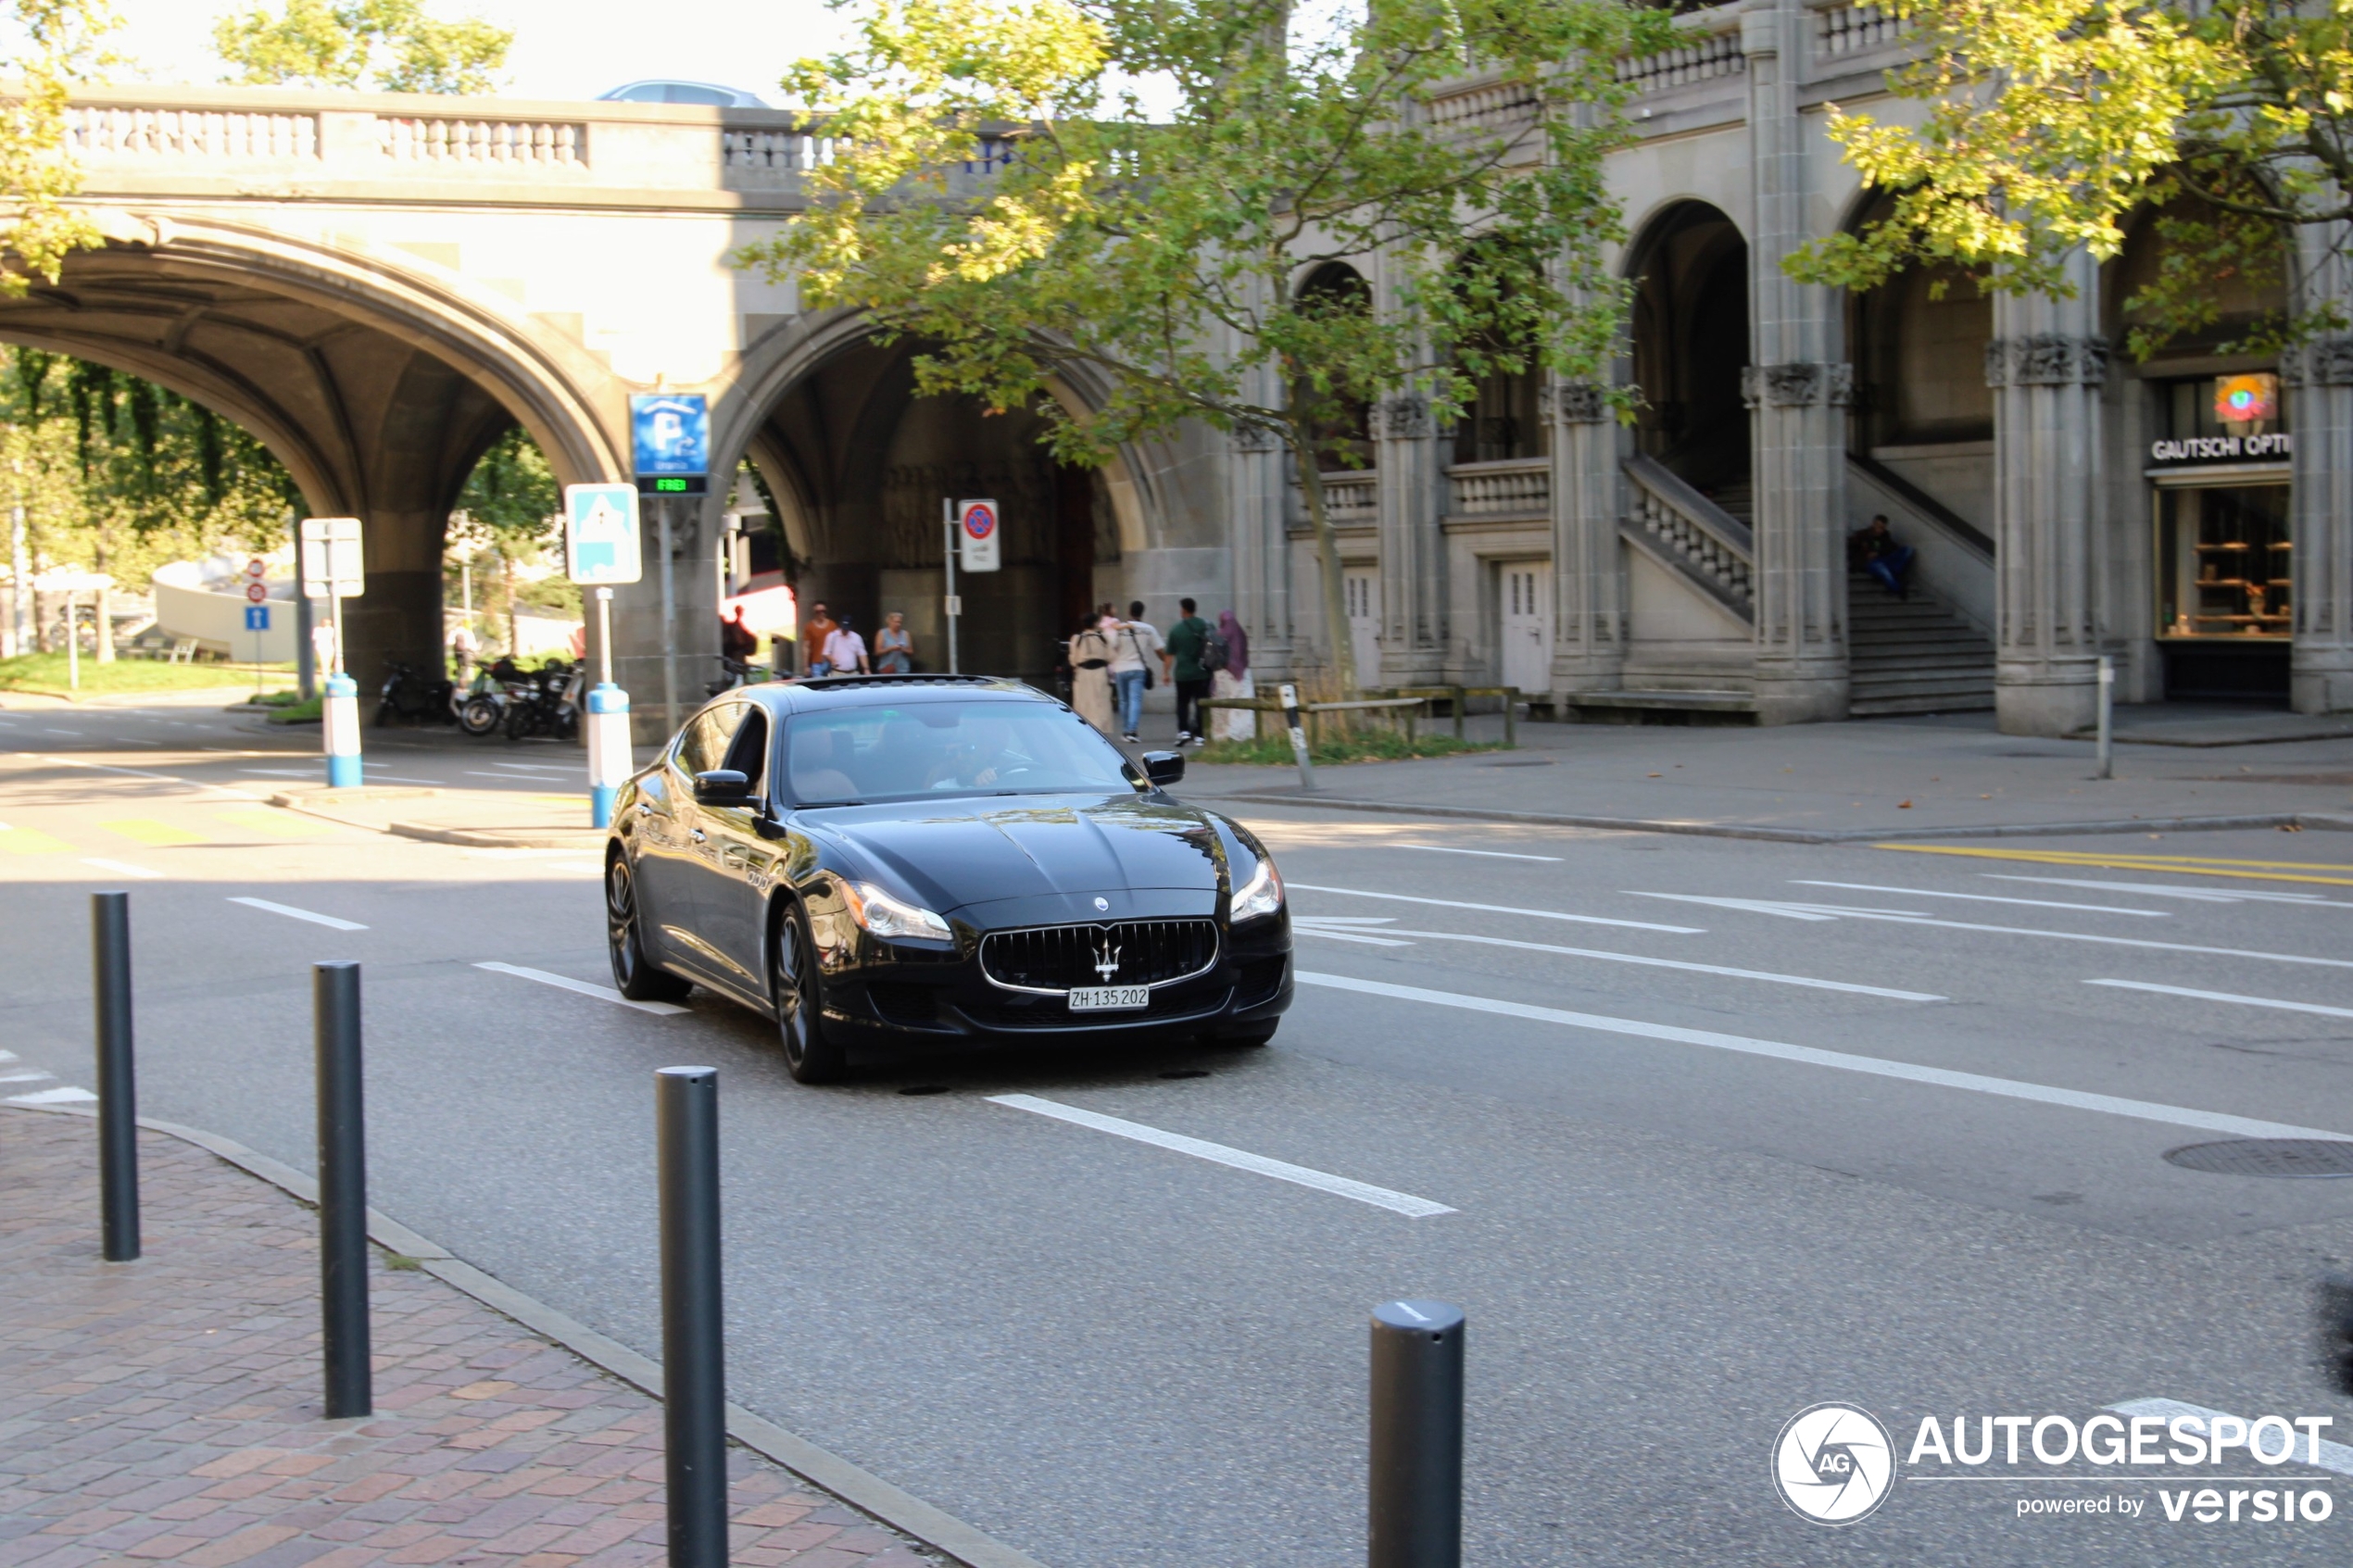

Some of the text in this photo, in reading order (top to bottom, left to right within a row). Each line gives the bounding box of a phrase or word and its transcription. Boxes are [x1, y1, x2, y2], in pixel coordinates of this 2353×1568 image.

[654, 412, 682, 450] P
[2151, 433, 2294, 459] GAUTSCHI OPTI
[657, 479, 686, 492] FREI
[1072, 991, 1089, 1007] ZH
[1122, 988, 1148, 1005] 202
